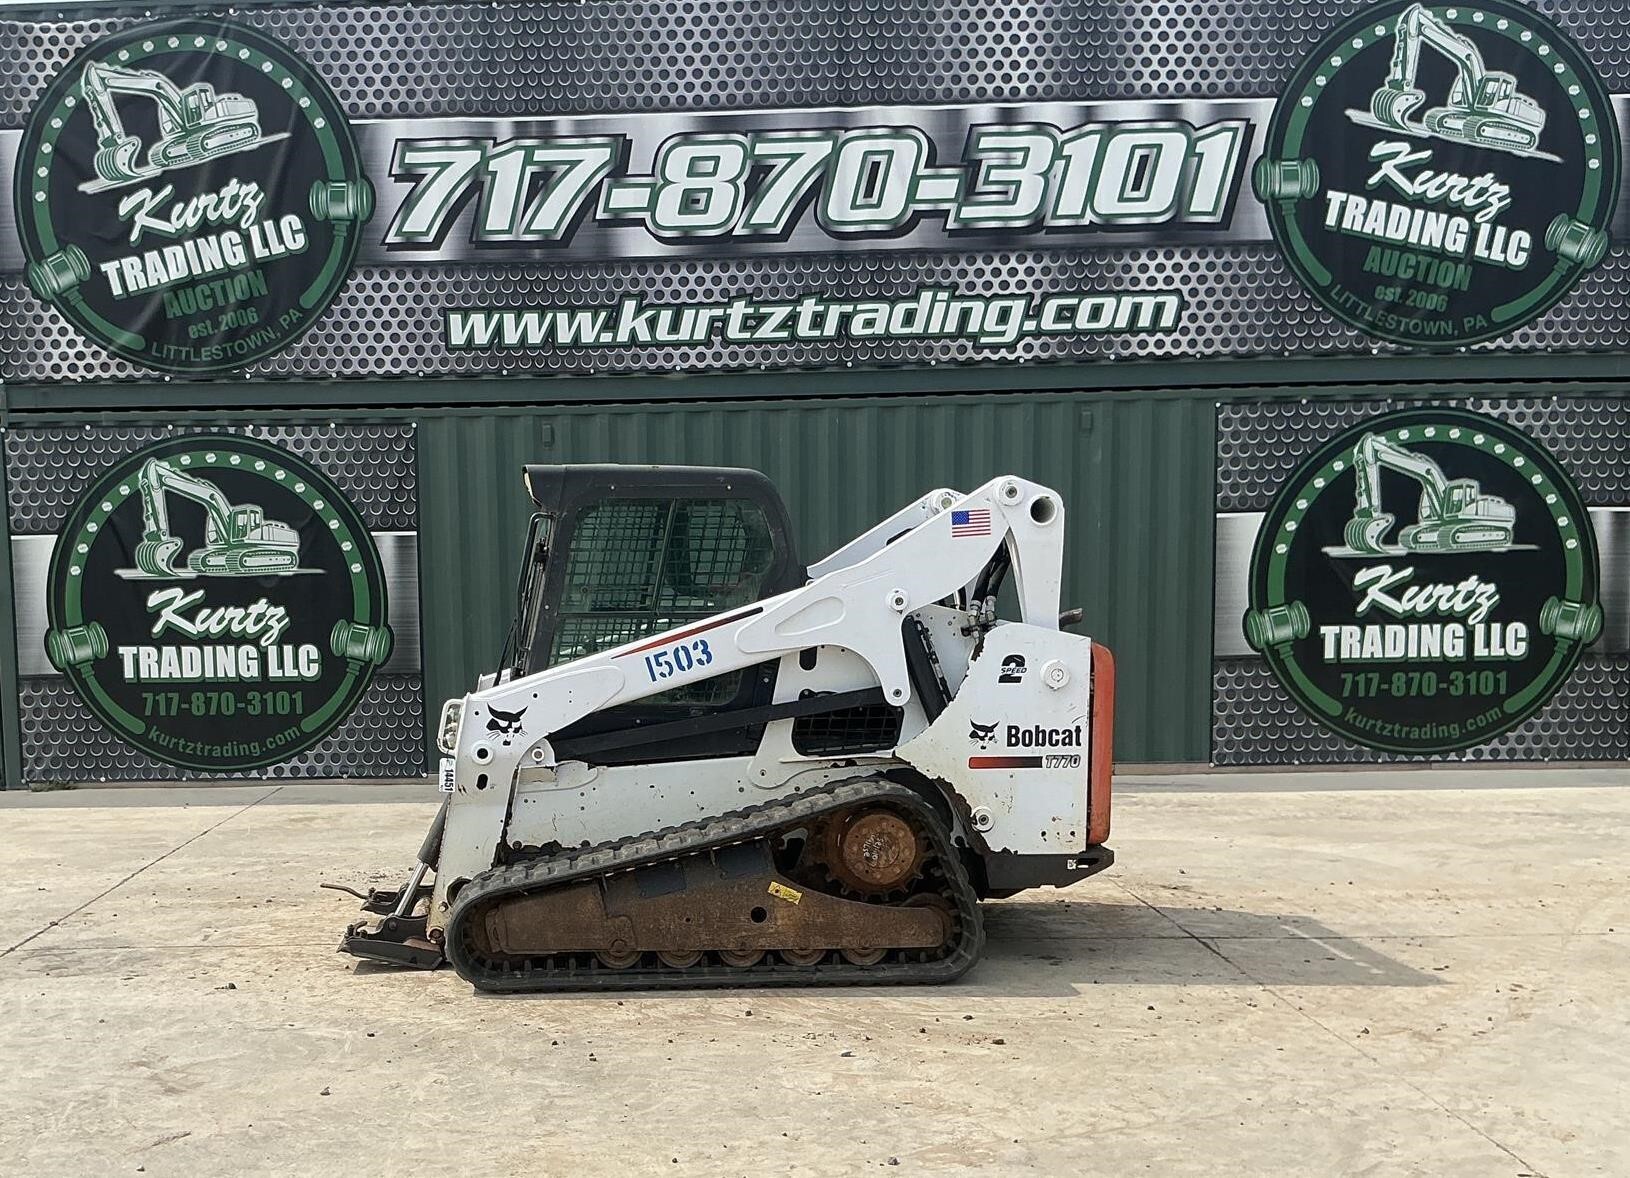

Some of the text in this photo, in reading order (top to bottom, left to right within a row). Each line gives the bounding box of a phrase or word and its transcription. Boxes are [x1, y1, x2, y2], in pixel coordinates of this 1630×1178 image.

[385, 119, 1251, 250] 717-870-3101
[1367, 141, 1511, 223] Kurtz
[119, 178, 264, 242] Kurtz
[1325, 190, 1531, 266] TRADING LLC
[101, 214, 306, 296] TRADING LLC
[1363, 245, 1473, 291] AUCTION
[163, 270, 269, 319] AUCTION
[1330, 284, 1488, 336] LITTLESTOWN, PA
[1405, 289, 1448, 312] 2006
[152, 308, 303, 361] LITTLESTOWN, PA
[446, 287, 1182, 349] www.kurtztrading.com
[147, 588, 289, 647] Kurtz
[1354, 565, 1500, 625] Kurtz
[119, 644, 319, 679] TRADING LLC
[644, 639, 714, 682] 1503
[1320, 622, 1527, 659] TRADING LLC
[998, 654, 1026, 683] 2
[1341, 671, 1507, 698] 717-870-3101
[142, 692, 303, 717] 717-870-3101
[1345, 706, 1502, 740] kurtztrading.com
[148, 724, 300, 758] kurtztrading.com
[1006, 725, 1082, 747] Bobcat
[1045, 754, 1081, 768] T770
